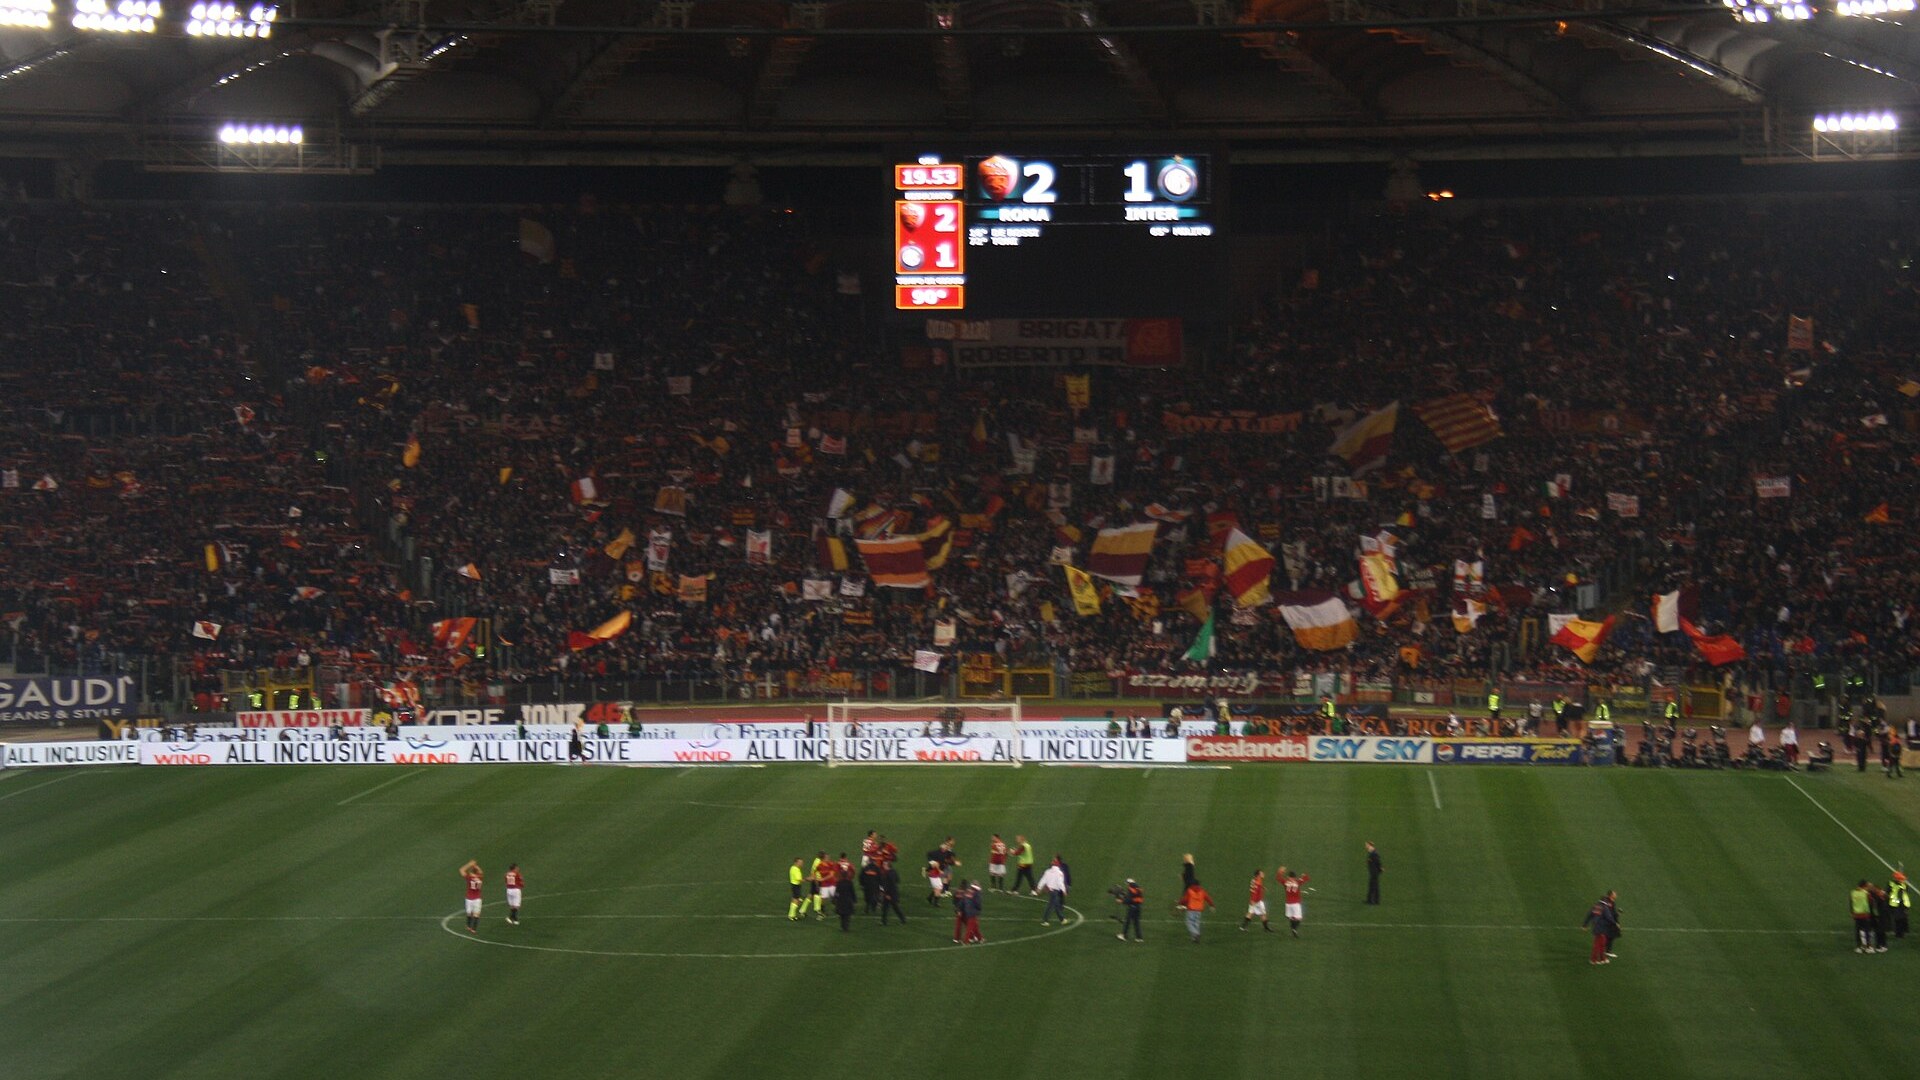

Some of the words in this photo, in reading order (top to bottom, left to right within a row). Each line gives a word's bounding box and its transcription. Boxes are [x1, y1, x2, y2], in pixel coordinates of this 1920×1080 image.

[902, 169, 957, 185] 19.53
[1022, 164, 1056, 203] 2
[1124, 163, 1153, 202] 1
[934, 207, 956, 232] 2
[999, 207, 1050, 222] ROMA
[1124, 206, 1179, 221] INTER
[936, 244, 955, 268] 1
[54, 710, 68, 720] &
[8, 747, 39, 764] ALL
[45, 744, 136, 763] INCLUSIVE
[226, 743, 265, 763] ALL
[274, 742, 386, 763] INCLUSIVE
[470, 742, 509, 762] ALL
[674, 751, 732, 762] WIND
[747, 740, 786, 760] ALL
[795, 739, 907, 760] INCLUSIVE
[1041, 739, 1155, 760] INCLUSIVE
[1187, 738, 1307, 758] Casalandia
[1314, 738, 1366, 760] SKY
[1374, 738, 1428, 760] SKY
[1461, 745, 1525, 759] PEPSI
[153, 753, 212, 765] WIND
[392, 752, 458, 765] WIND
